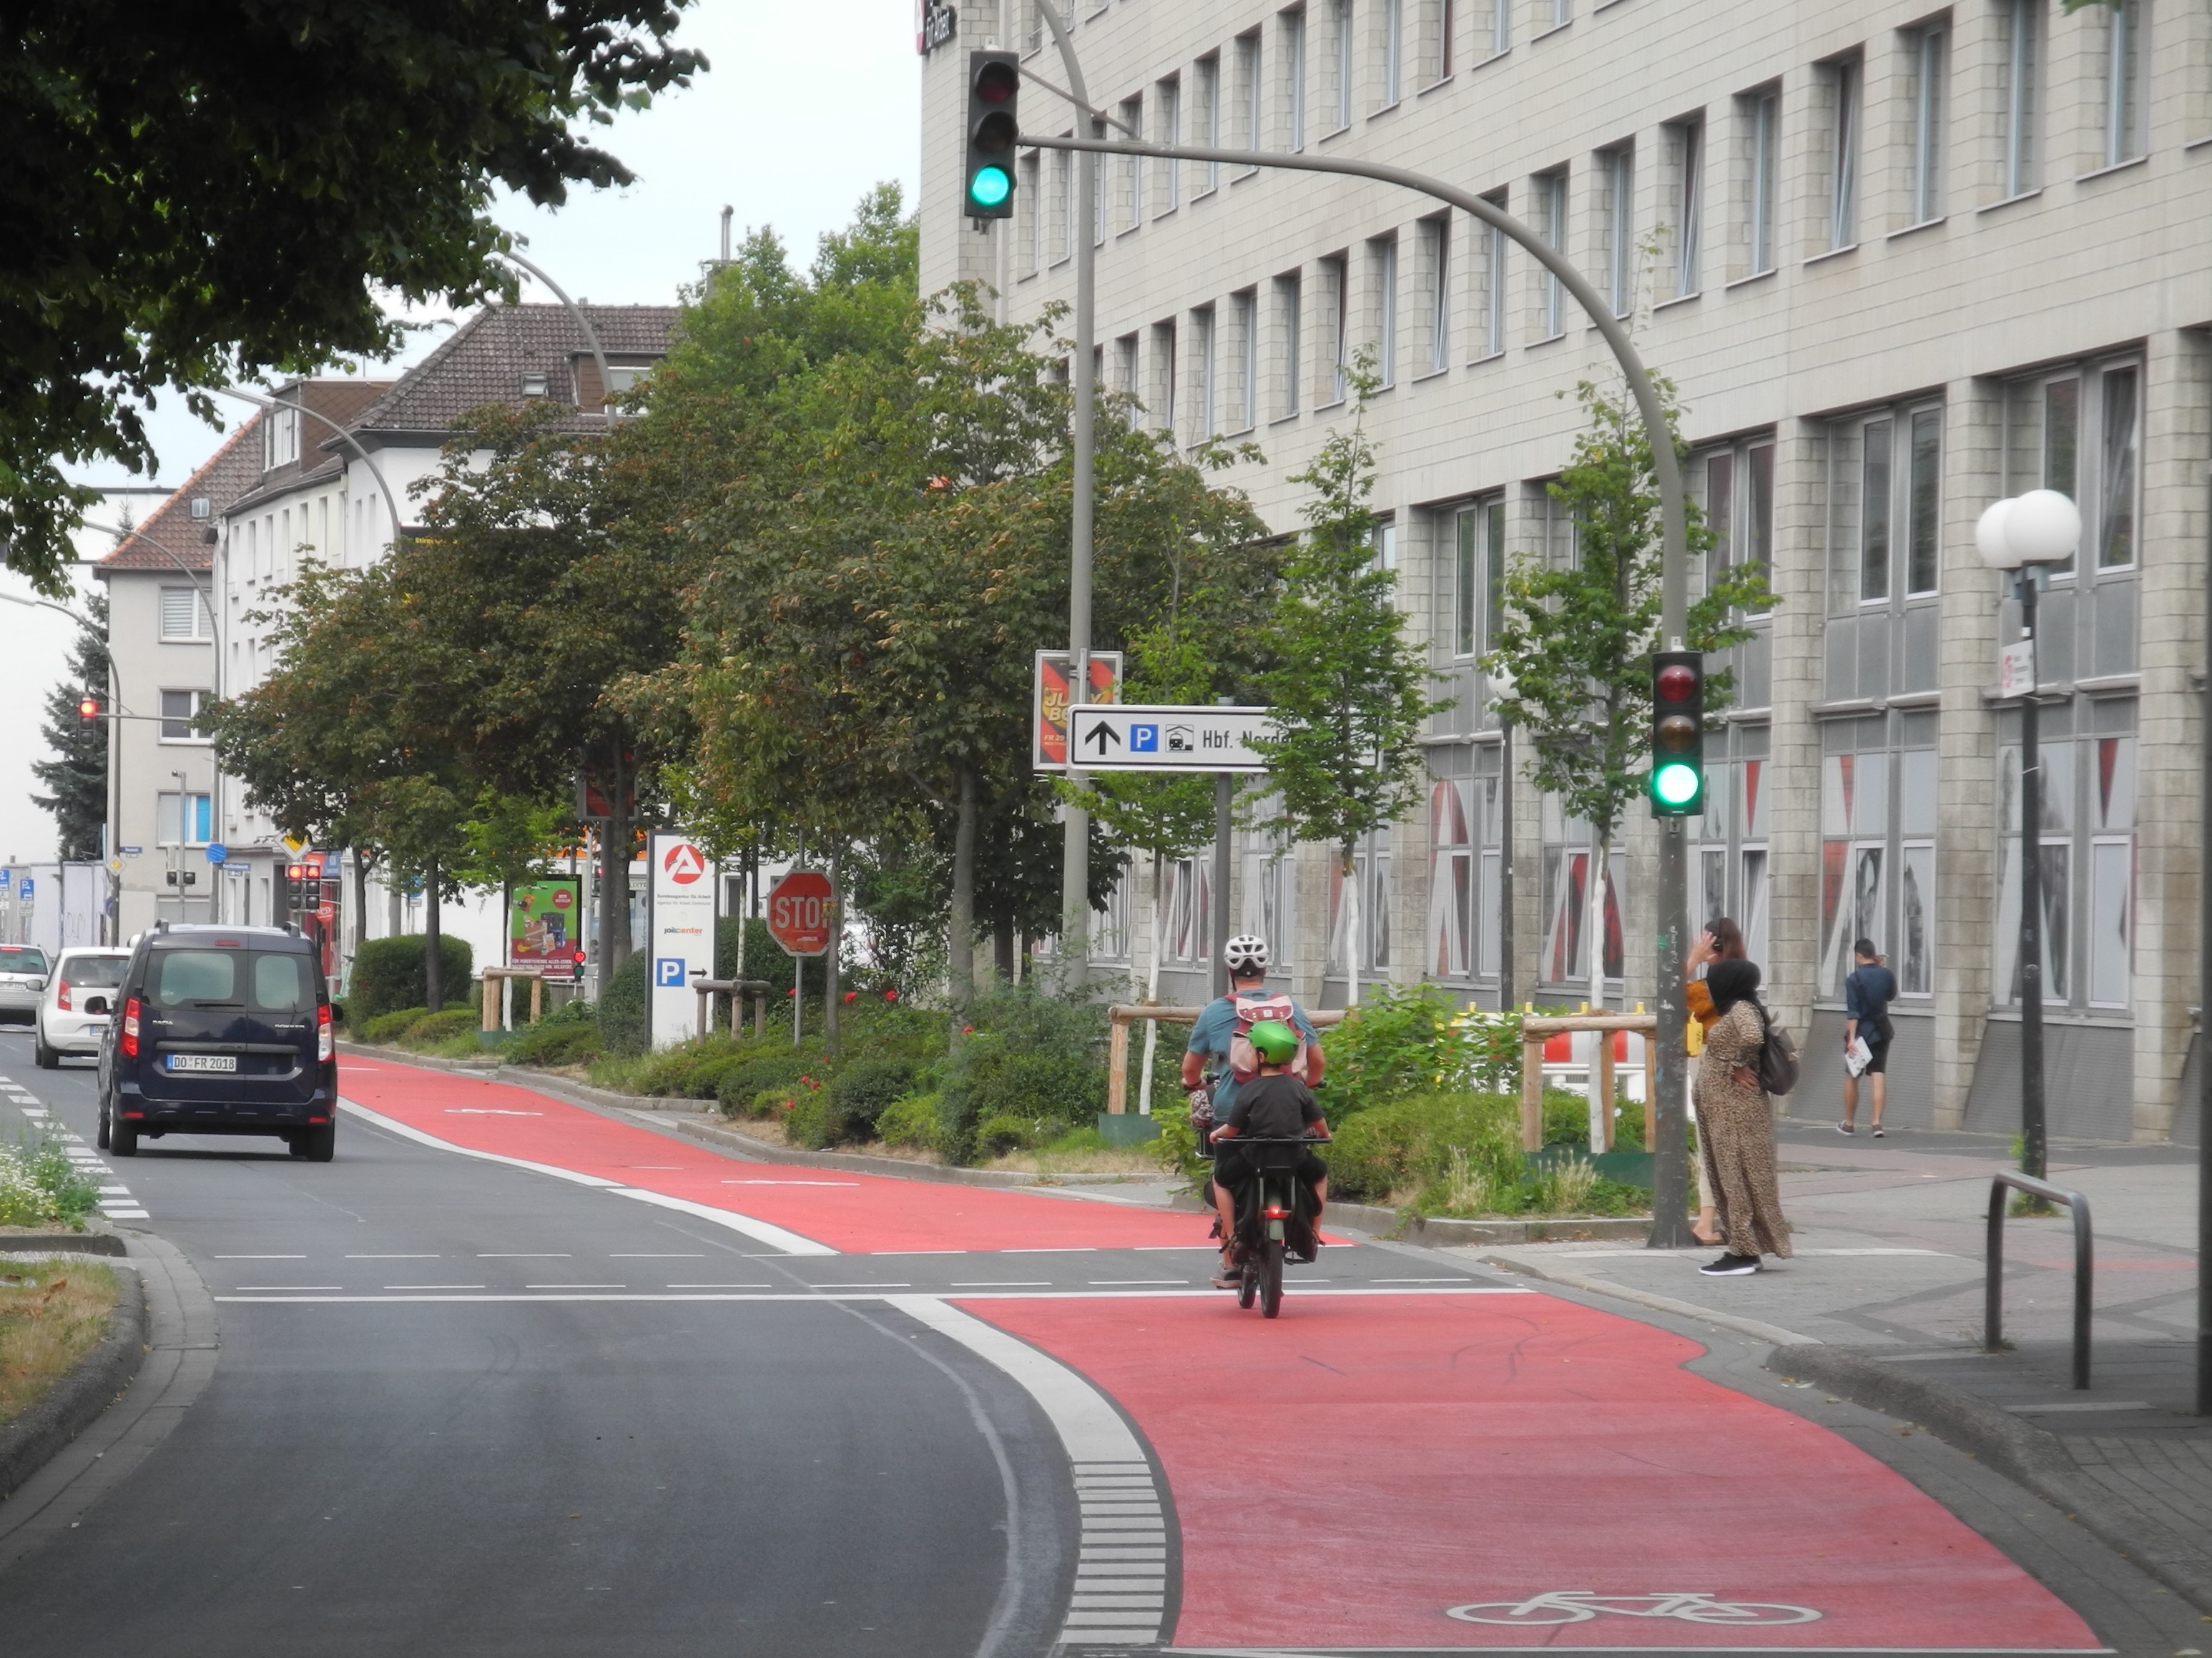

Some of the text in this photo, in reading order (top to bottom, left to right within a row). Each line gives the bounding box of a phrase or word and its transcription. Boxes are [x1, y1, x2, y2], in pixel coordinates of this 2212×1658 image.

[1045, 693, 1102, 706] JUY
[1136, 728, 1151, 748] P
[1203, 730, 1233, 748] Hbf.
[662, 962, 680, 984] P
[174, 1057, 235, 1070] DO FR 2018
